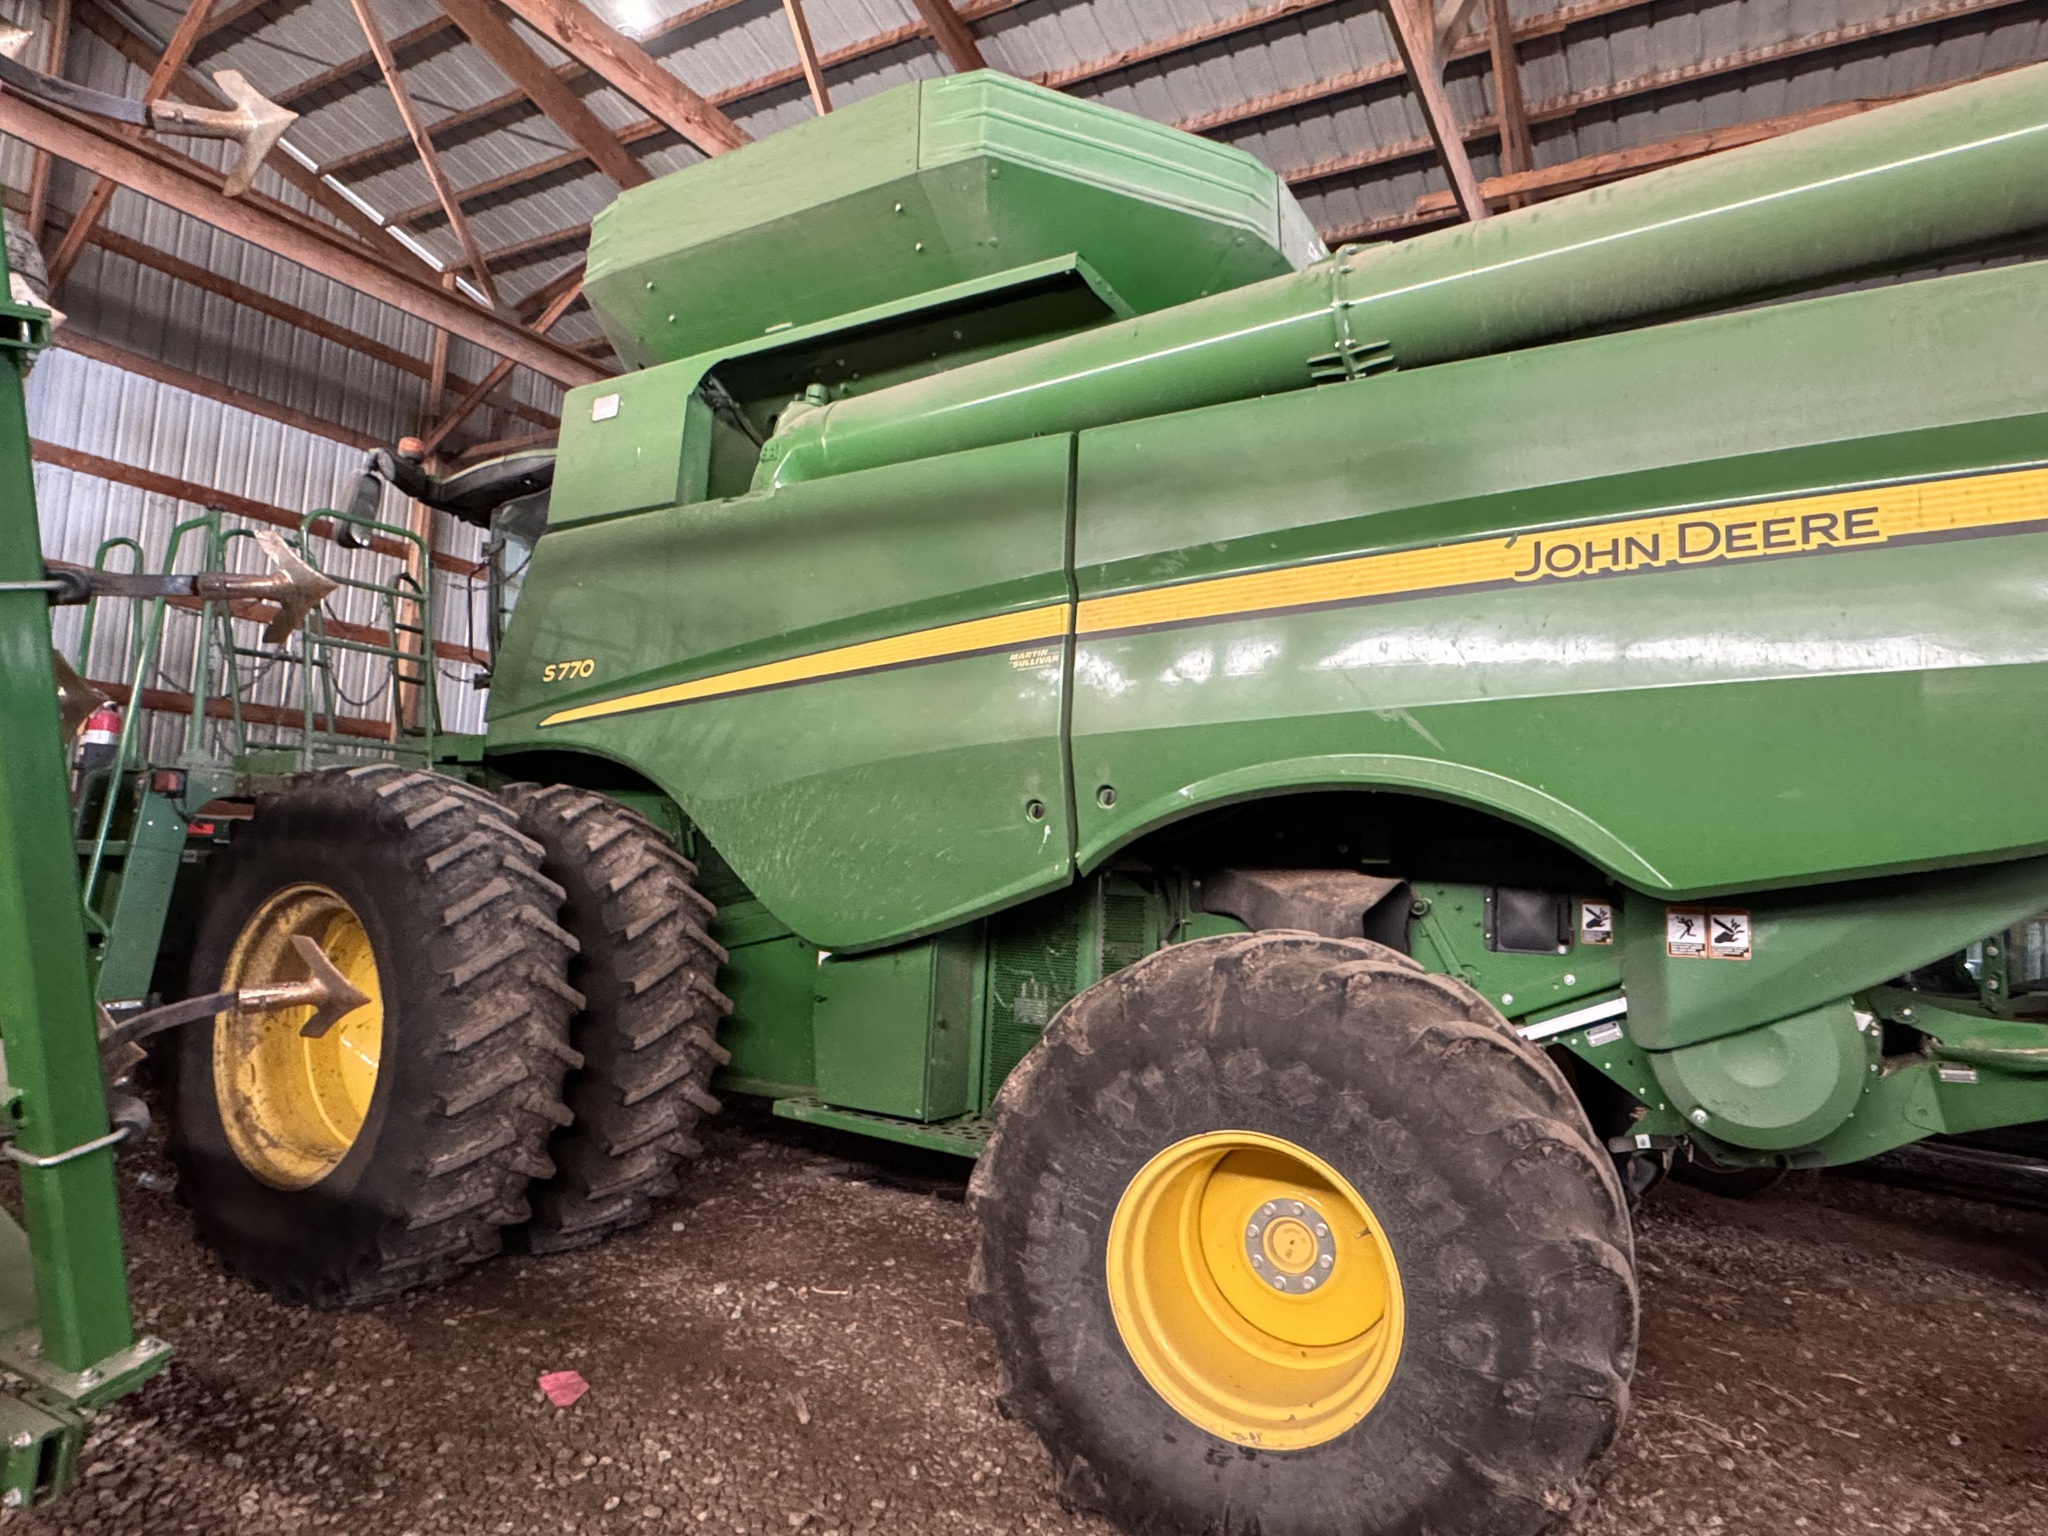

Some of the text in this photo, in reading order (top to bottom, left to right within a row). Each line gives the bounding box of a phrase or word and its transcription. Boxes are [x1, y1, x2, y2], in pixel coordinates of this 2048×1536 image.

[1514, 506, 1880, 577] JOHN DEERE
[1010, 649, 1049, 661] MARTIN
[1012, 654, 1059, 669] SULLIVAN
[542, 659, 595, 682] S770
